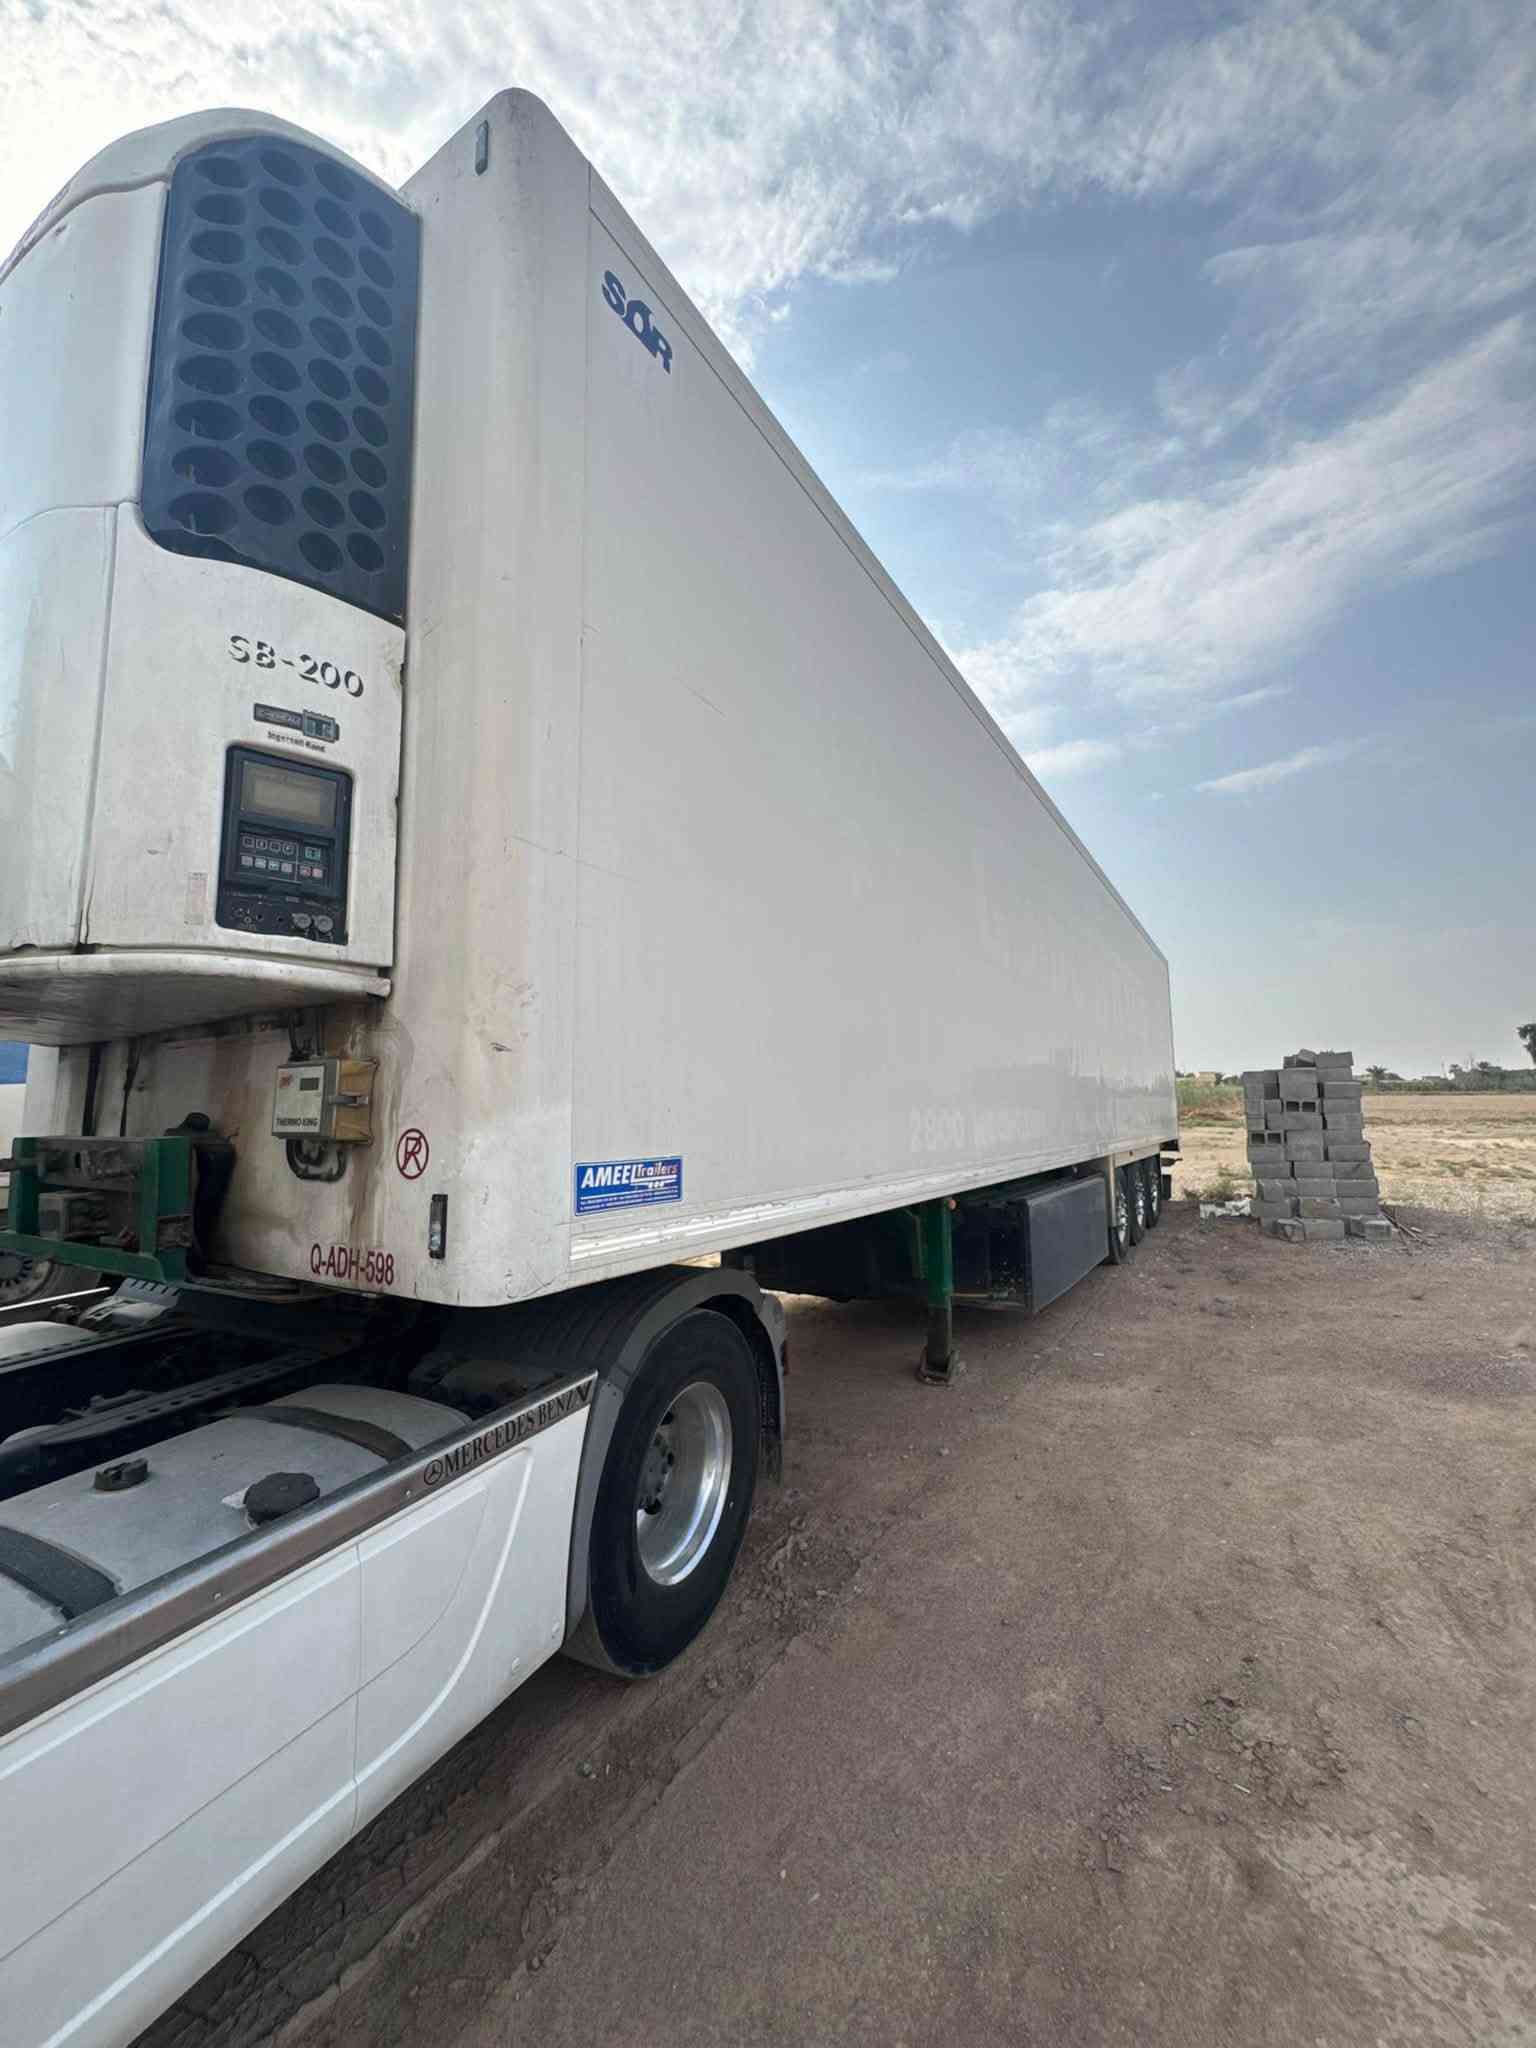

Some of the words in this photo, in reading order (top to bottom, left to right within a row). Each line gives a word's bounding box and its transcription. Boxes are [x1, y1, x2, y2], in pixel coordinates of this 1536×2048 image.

[227, 634, 365, 698] SB-200
[581, 1164, 640, 1189] AMEEL
[310, 1242, 395, 1286] Q-ADH-598
[443, 1413, 537, 1474] MERCEDES
[537, 1391, 575, 1426] BENZ
